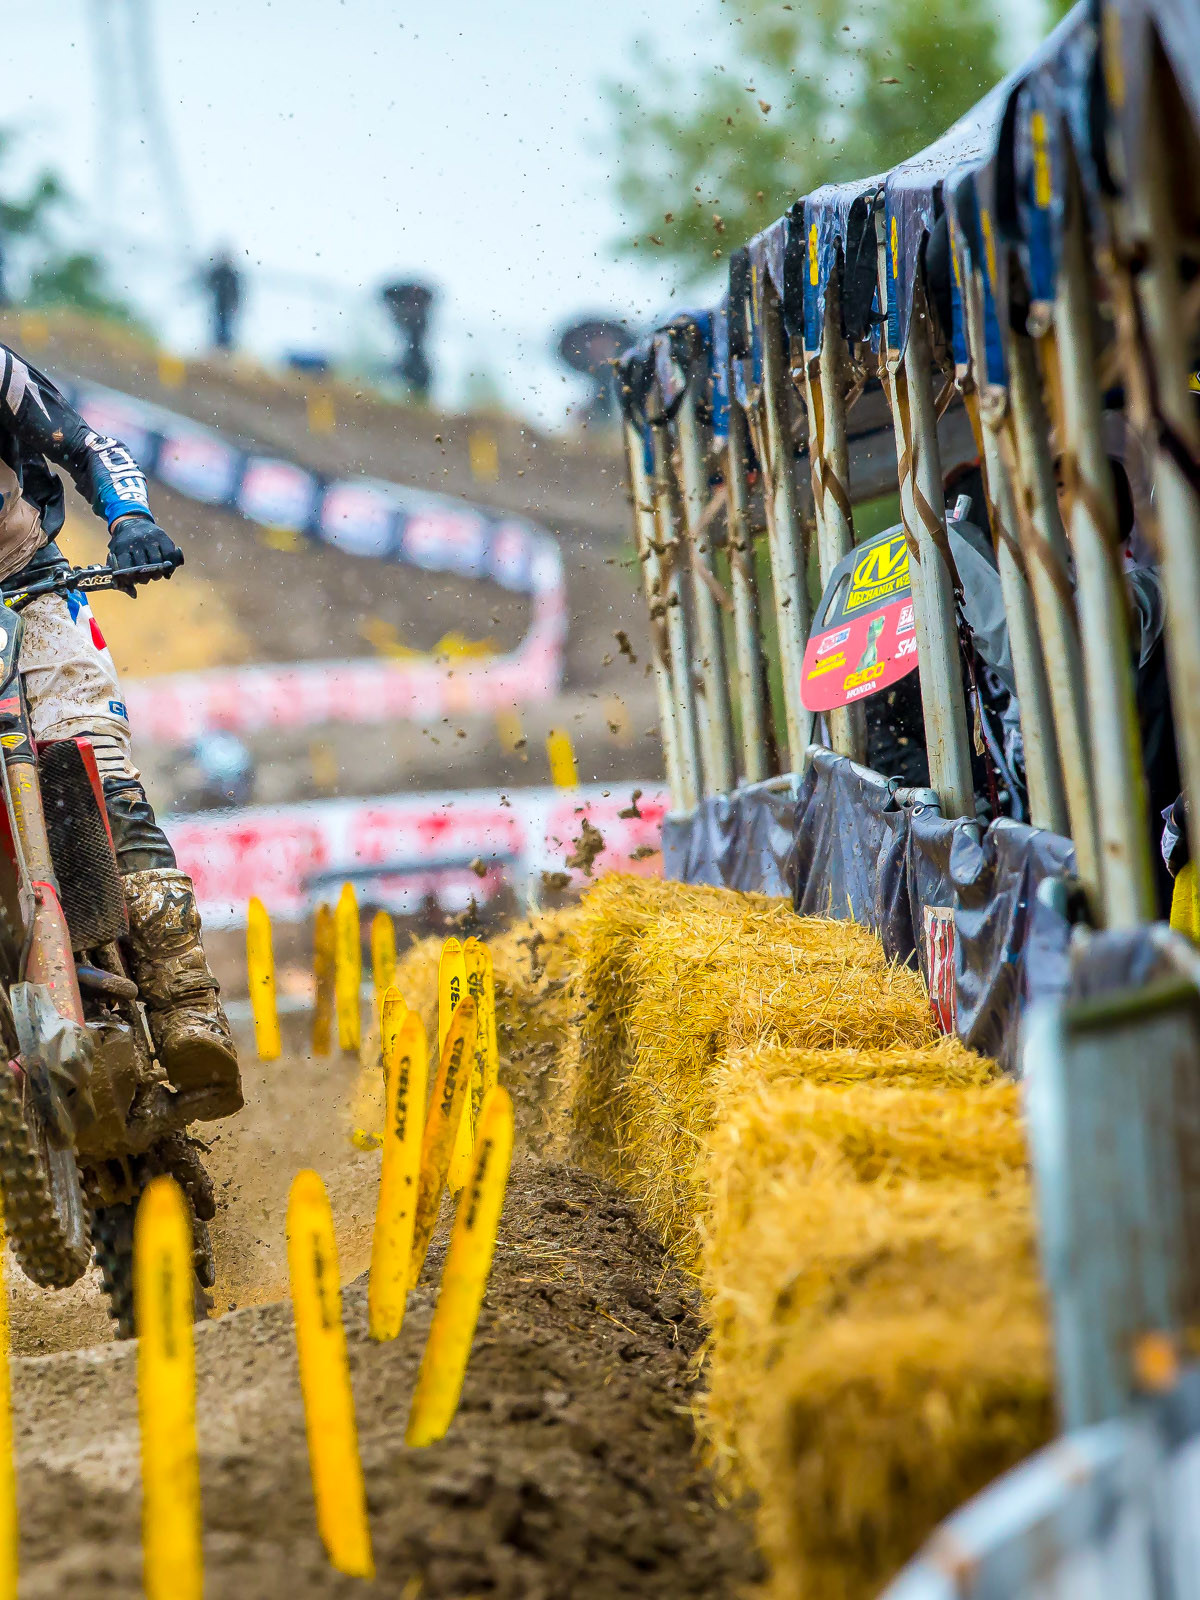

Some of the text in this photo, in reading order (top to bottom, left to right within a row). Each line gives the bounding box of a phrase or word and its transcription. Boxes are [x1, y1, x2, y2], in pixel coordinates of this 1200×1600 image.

[77, 574, 112, 587] ARC
[847, 580, 896, 610] MECHANIX
[843, 661, 885, 691] GEICO
[846, 680, 876, 699] HONDA
